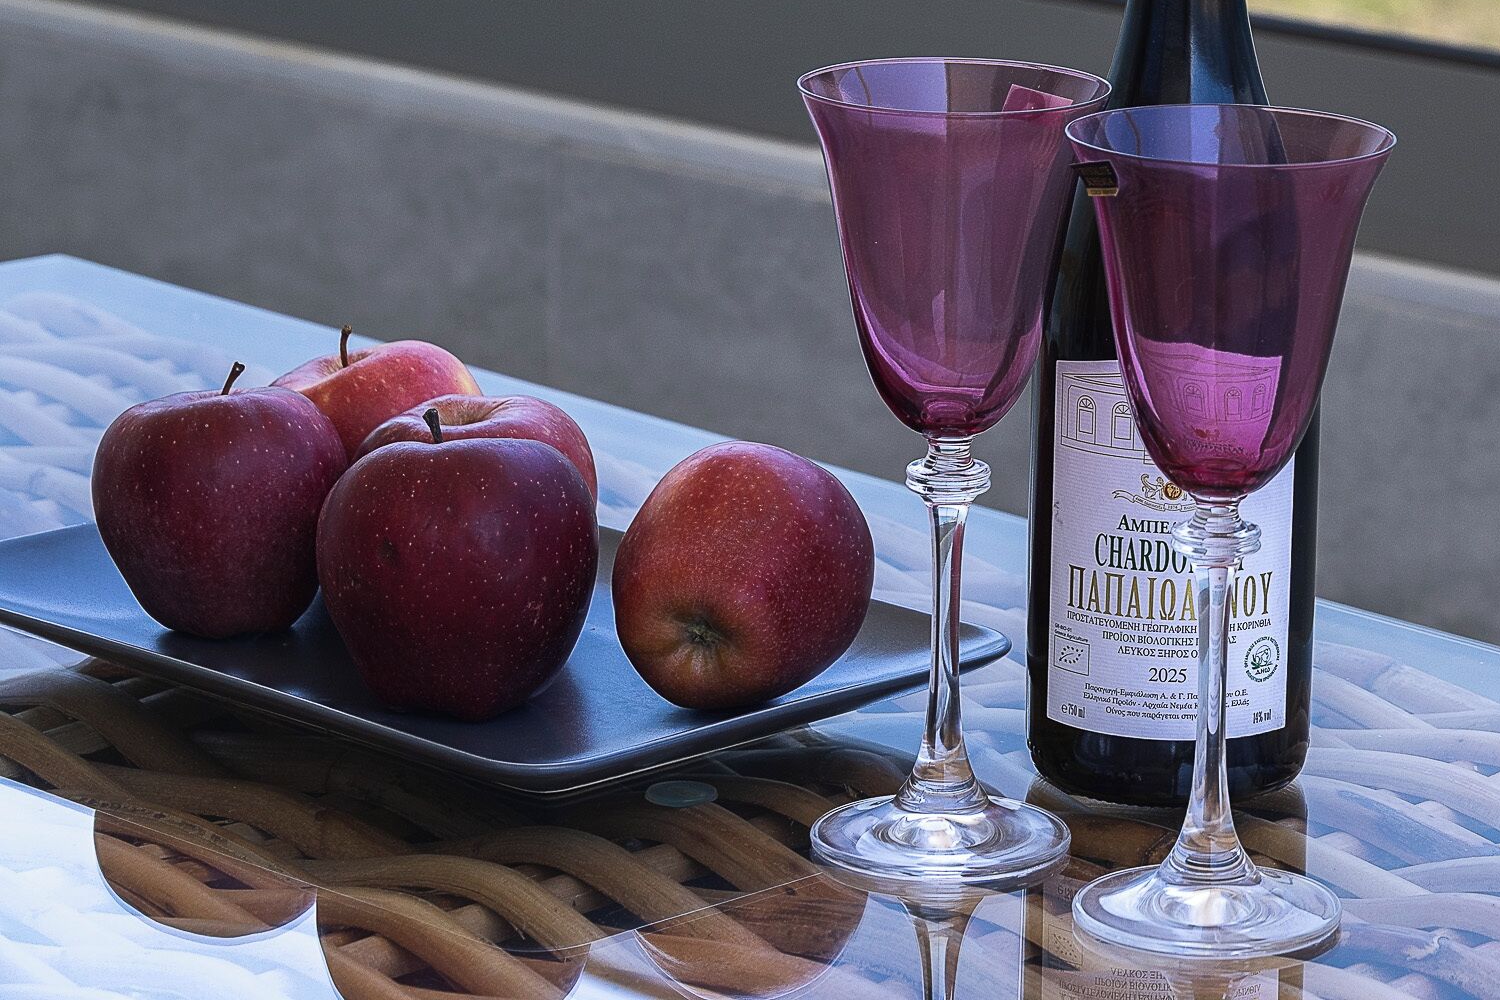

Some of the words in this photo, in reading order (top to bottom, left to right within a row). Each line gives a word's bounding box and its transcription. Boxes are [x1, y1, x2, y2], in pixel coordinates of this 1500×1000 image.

[1067, 610, 1140, 632] ΠΡΟΣΤΑΤΕΥΟΜΕΝΗ
[1142, 622, 1197, 634] ΓΕΩΓΡΑΦΙΚΗ
[1236, 618, 1272, 632] ΚΟΡΙΝΘΙΑ
[1137, 635, 1193, 646] ΒΙΟΛΟΓΙΚΗΣ
[1117, 645, 1156, 657] ΛΕΥΚΟΣ
[1157, 648, 1189, 659] ΞΗΡΟΣ
[1148, 667, 1187, 683] 2025
[1142, 701, 1169, 709] Αρχαία
[1170, 702, 1193, 710] Νεμέα
[1105, 706, 1126, 717] Οίνος
[1141, 711, 1180, 720] παράγεται
